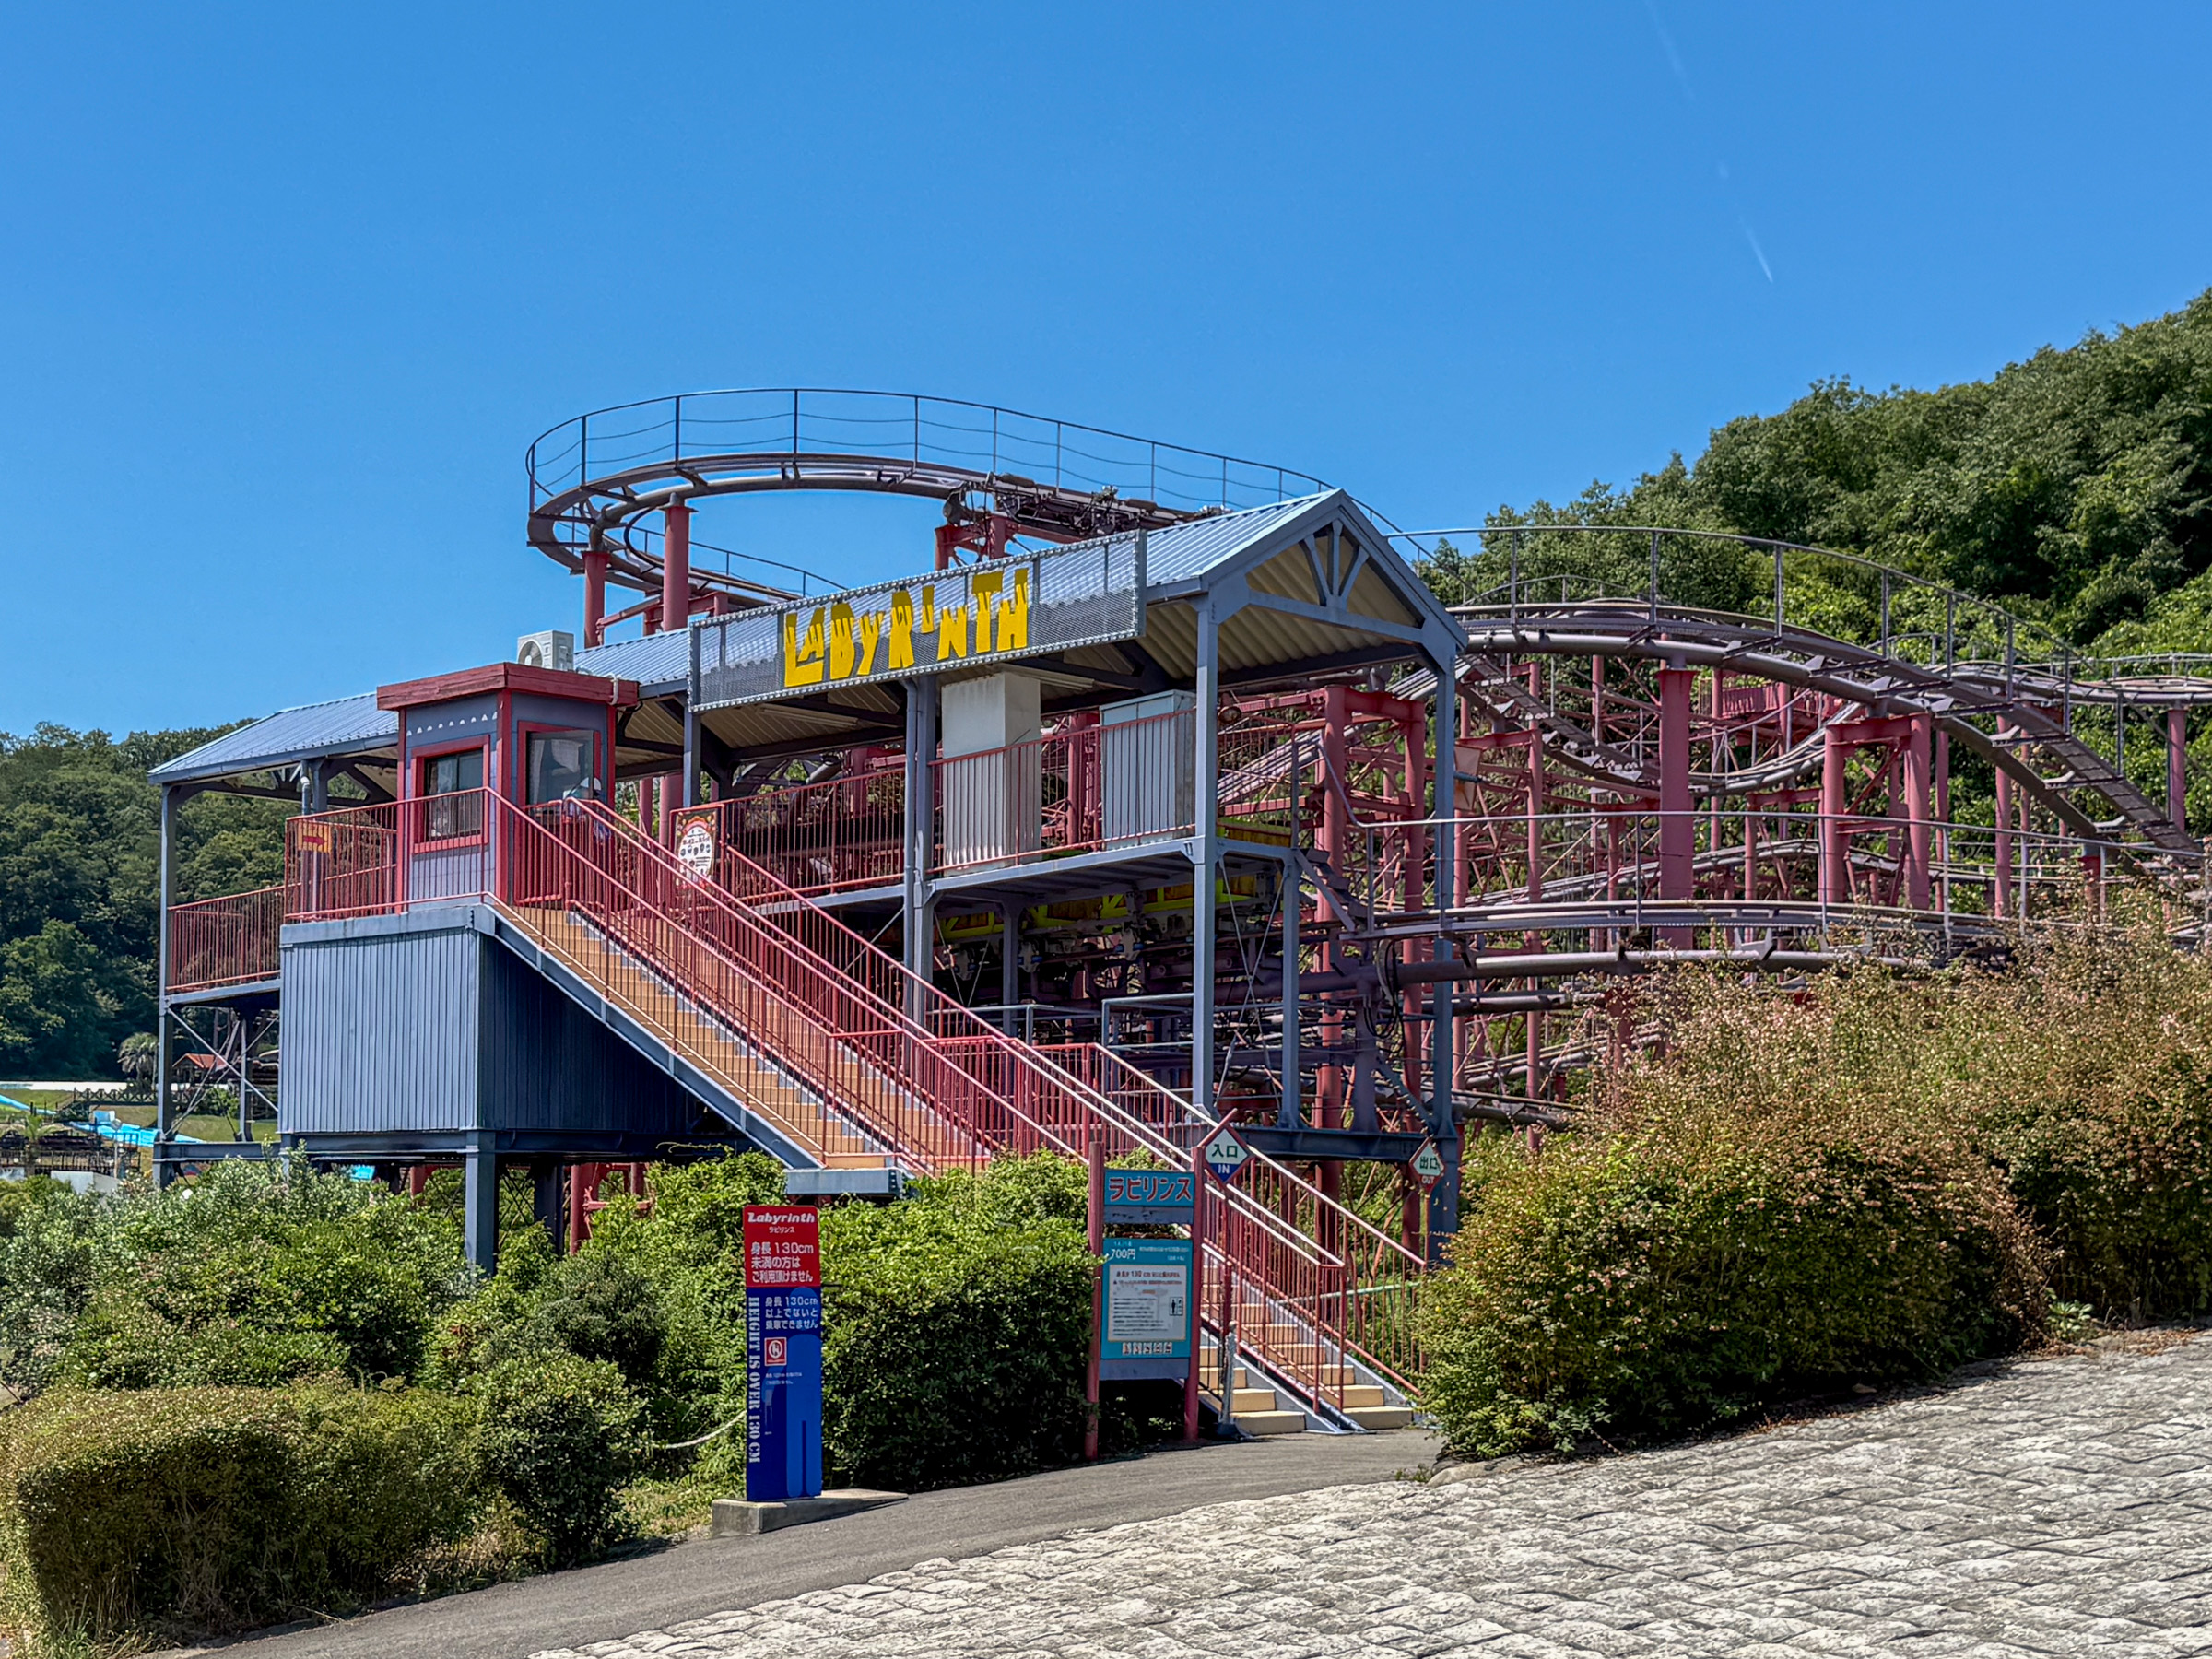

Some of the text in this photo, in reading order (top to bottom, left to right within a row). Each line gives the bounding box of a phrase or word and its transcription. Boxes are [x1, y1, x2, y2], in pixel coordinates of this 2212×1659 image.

[1211, 1143, 1239, 1159] 入口
[1218, 1164, 1230, 1174] IN
[1419, 1156, 1440, 1170] 出口
[1109, 1176, 1192, 1202] ラビリンス
[747, 1212, 816, 1225] Labyrinth
[769, 1226, 795, 1234] ラビリンス
[1111, 1248, 1136, 1261] 700円
[751, 1256, 801, 1269] 未満の方は
[752, 1270, 814, 1284] ご利用頂けません
[765, 1308, 818, 1319] 以上でないと
[748, 1297, 761, 1464] HEIGHT IS OVER 130 CM
